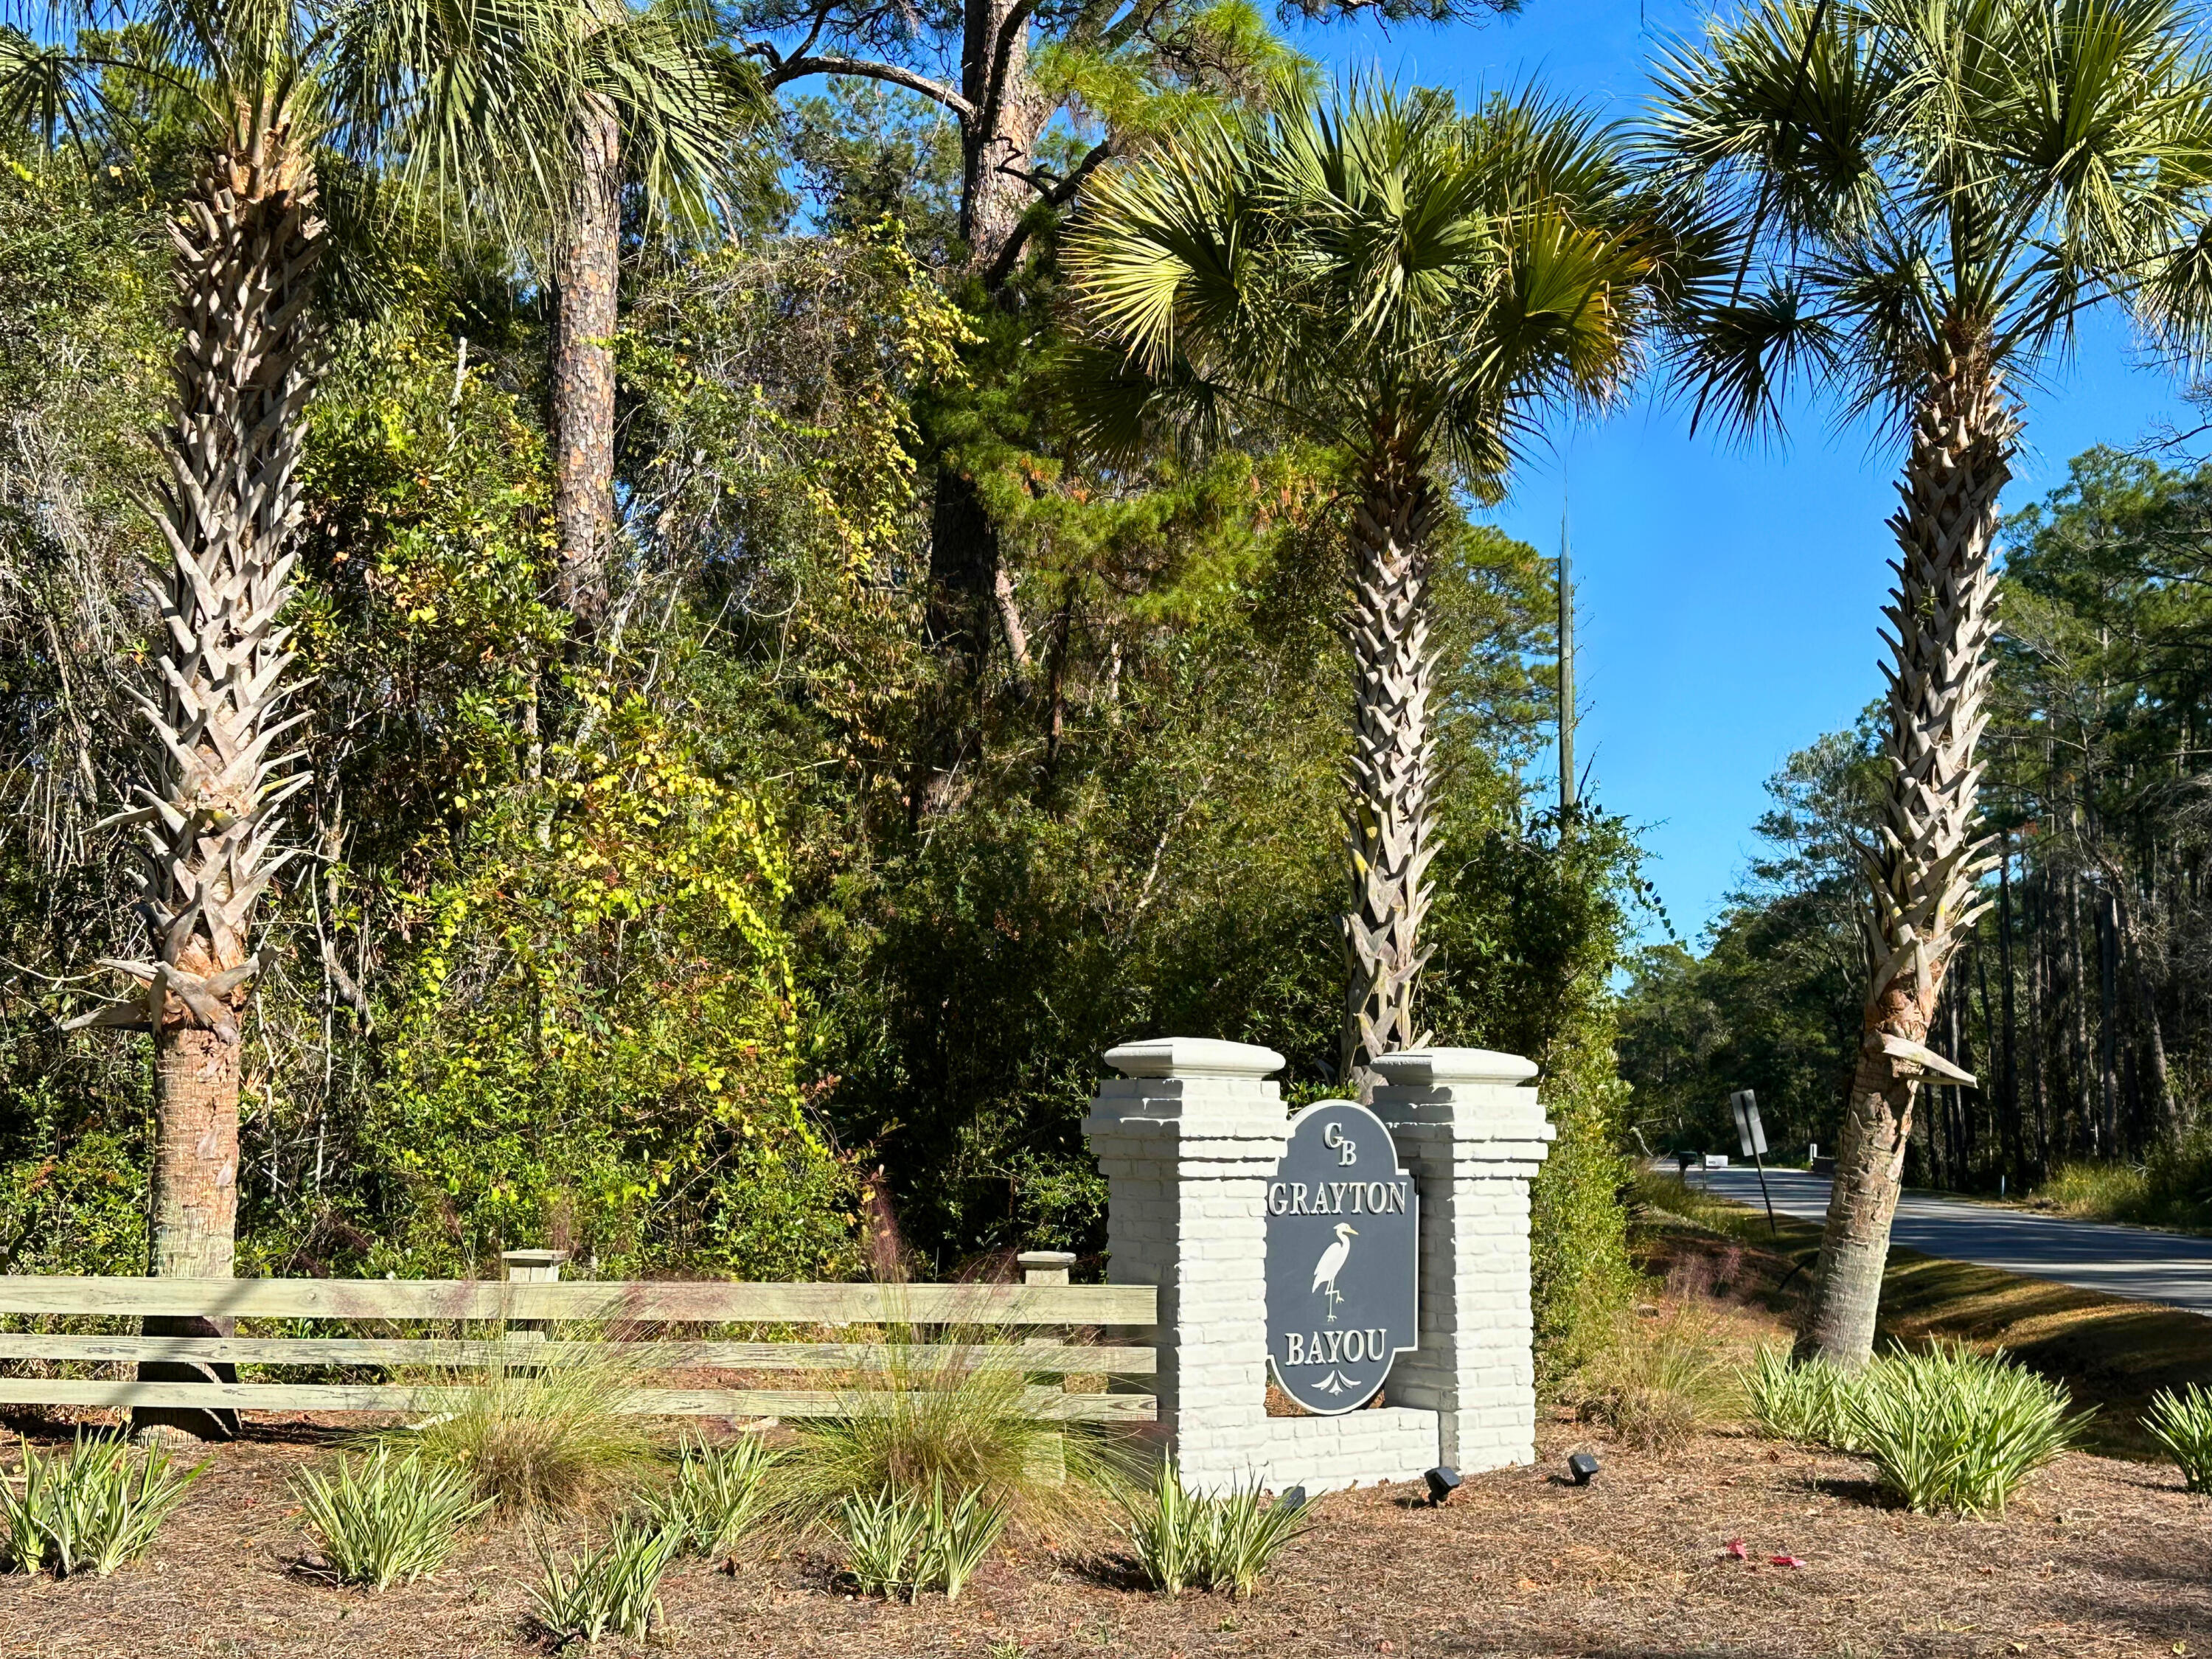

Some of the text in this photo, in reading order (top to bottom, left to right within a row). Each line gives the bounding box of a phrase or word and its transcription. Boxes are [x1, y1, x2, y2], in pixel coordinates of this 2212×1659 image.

[1324, 1122, 1357, 1166] GB
[1268, 1182, 1408, 1215] GRAYTON
[1284, 1329, 1387, 1366] BAYOU
